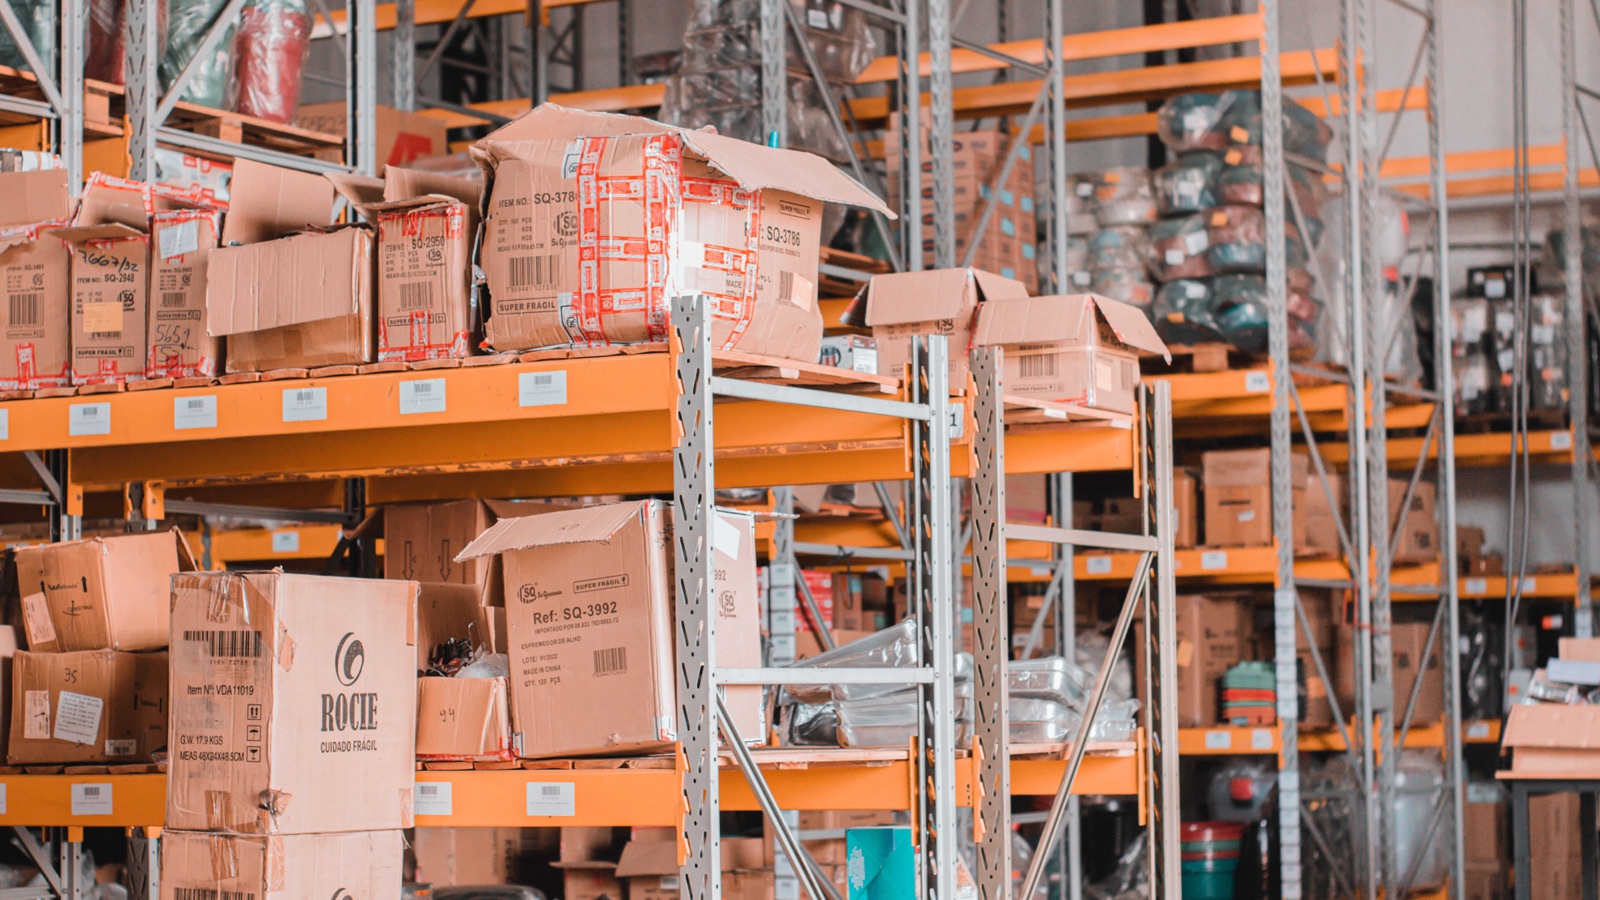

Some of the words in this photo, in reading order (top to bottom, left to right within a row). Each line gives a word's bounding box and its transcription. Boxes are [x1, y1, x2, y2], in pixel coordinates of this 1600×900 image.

[498, 198, 514, 208] ITEM
[766, 225, 801, 247] SQ-3786
[411, 236, 445, 249] SQ-2950
[77, 249, 140, 274] 7667/32
[104, 273, 135, 283] SQ-2948
[725, 279, 742, 289] MADE
[500, 303, 524, 312] SUPER
[526, 301, 556, 310] FRAGIL
[575, 581, 596, 590] SUPER
[597, 577, 620, 588] FRÁGIL
[533, 610, 558, 625] Ref:
[563, 601, 618, 621] SQ-3992
[535, 624, 563, 635] IMPORTADO
[563, 622, 574, 631] POR
[521, 637, 559, 650] ESPREMEDOR
[566, 635, 581, 644] ALHO
[523, 667, 538, 676] MADE
[538, 666, 544, 674] IN
[545, 665, 561, 673] CHINA
[524, 679, 537, 688] QTY:
[187, 685, 202, 696] Item
[216, 685, 254, 696] VDA11019
[320, 692, 378, 732] ROCIE
[209, 735, 223, 746] KGS
[320, 740, 352, 753] CUIDADO
[353, 737, 378, 751] FRÁGIL
[179, 751, 198, 761] MEAS
